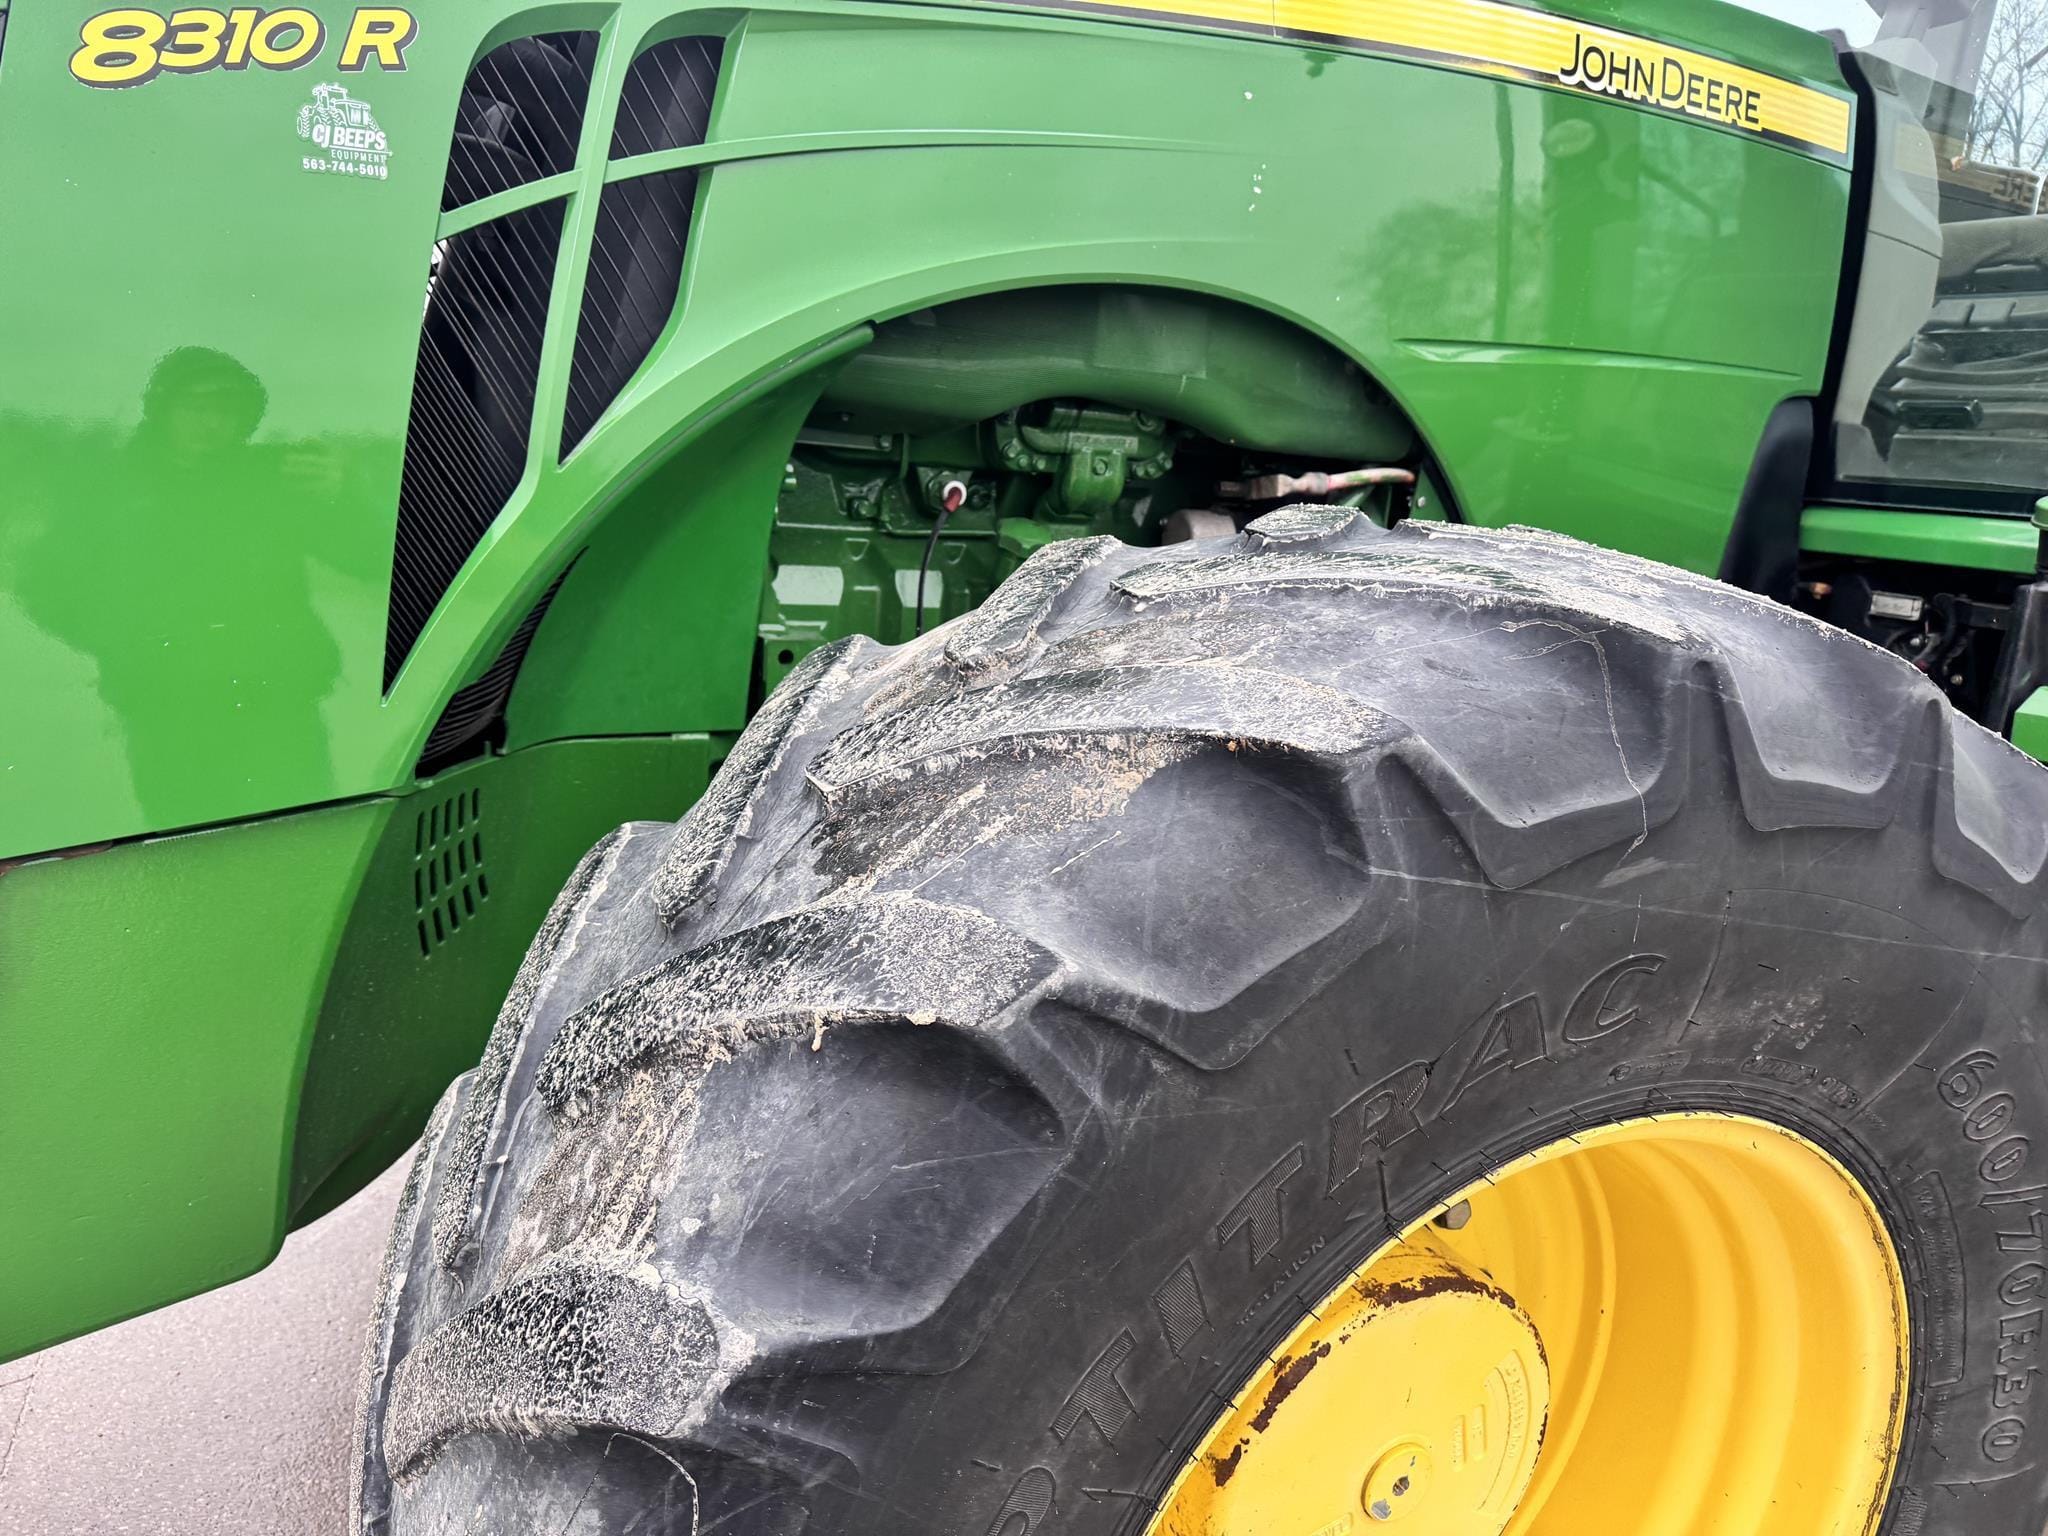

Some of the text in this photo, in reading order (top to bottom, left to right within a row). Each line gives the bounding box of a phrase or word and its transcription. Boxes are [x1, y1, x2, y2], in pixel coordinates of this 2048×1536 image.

[68, 7, 419, 90] 8310 R
[1559, 34, 1761, 124] JOHN DEERE
[312, 123, 386, 150] CJ BEEPS
[302, 157, 387, 178] 563-744-5010
[331, 149, 386, 163] EQUIPMENT
